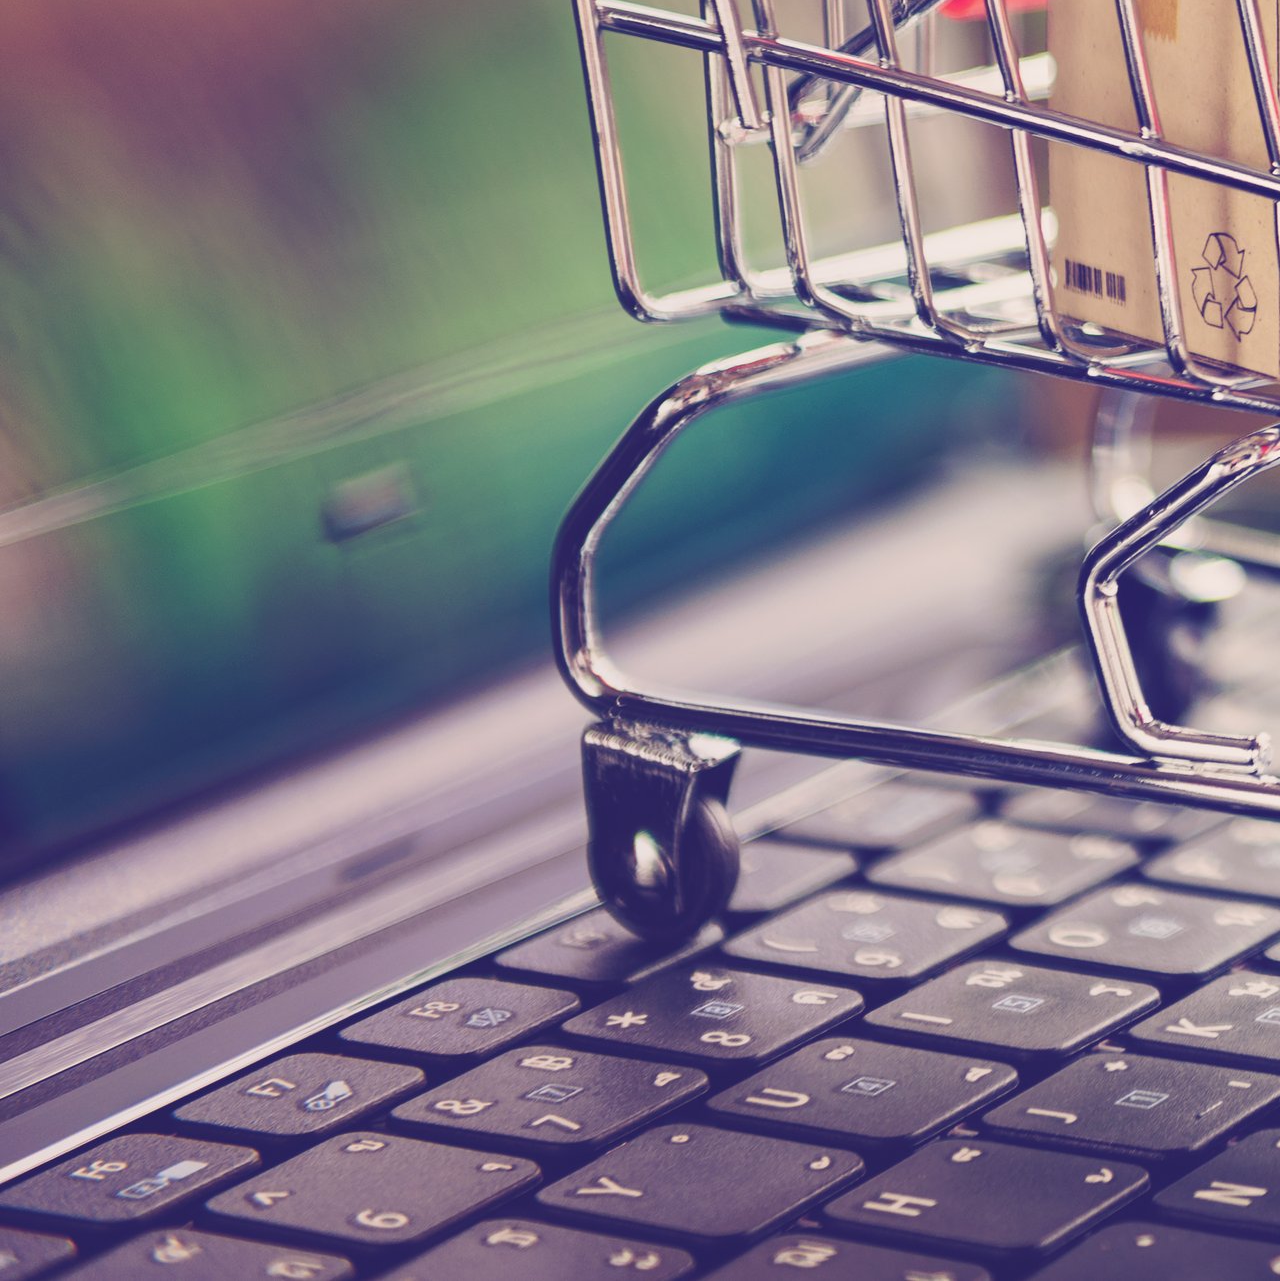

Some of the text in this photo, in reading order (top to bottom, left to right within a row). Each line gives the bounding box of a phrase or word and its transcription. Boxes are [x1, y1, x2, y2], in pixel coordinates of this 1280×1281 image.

[853, 949, 901, 968] 9
[409, 1001, 460, 1018] F8
[901, 1012, 953, 1025] I
[1165, 1018, 1233, 1038] K
[700, 1031, 751, 1047] 8
[247, 1077, 296, 1097] F7
[434, 1099, 494, 1115] &
[745, 1087, 811, 1108] U
[531, 1114, 581, 1131] 7
[1026, 1107, 1077, 1124] J
[70, 1160, 128, 1180] F6
[576, 1176, 643, 1197] Y
[1193, 1181, 1267, 1206] N
[863, 1192, 937, 1216] H
[356, 1209, 409, 1229] 6
